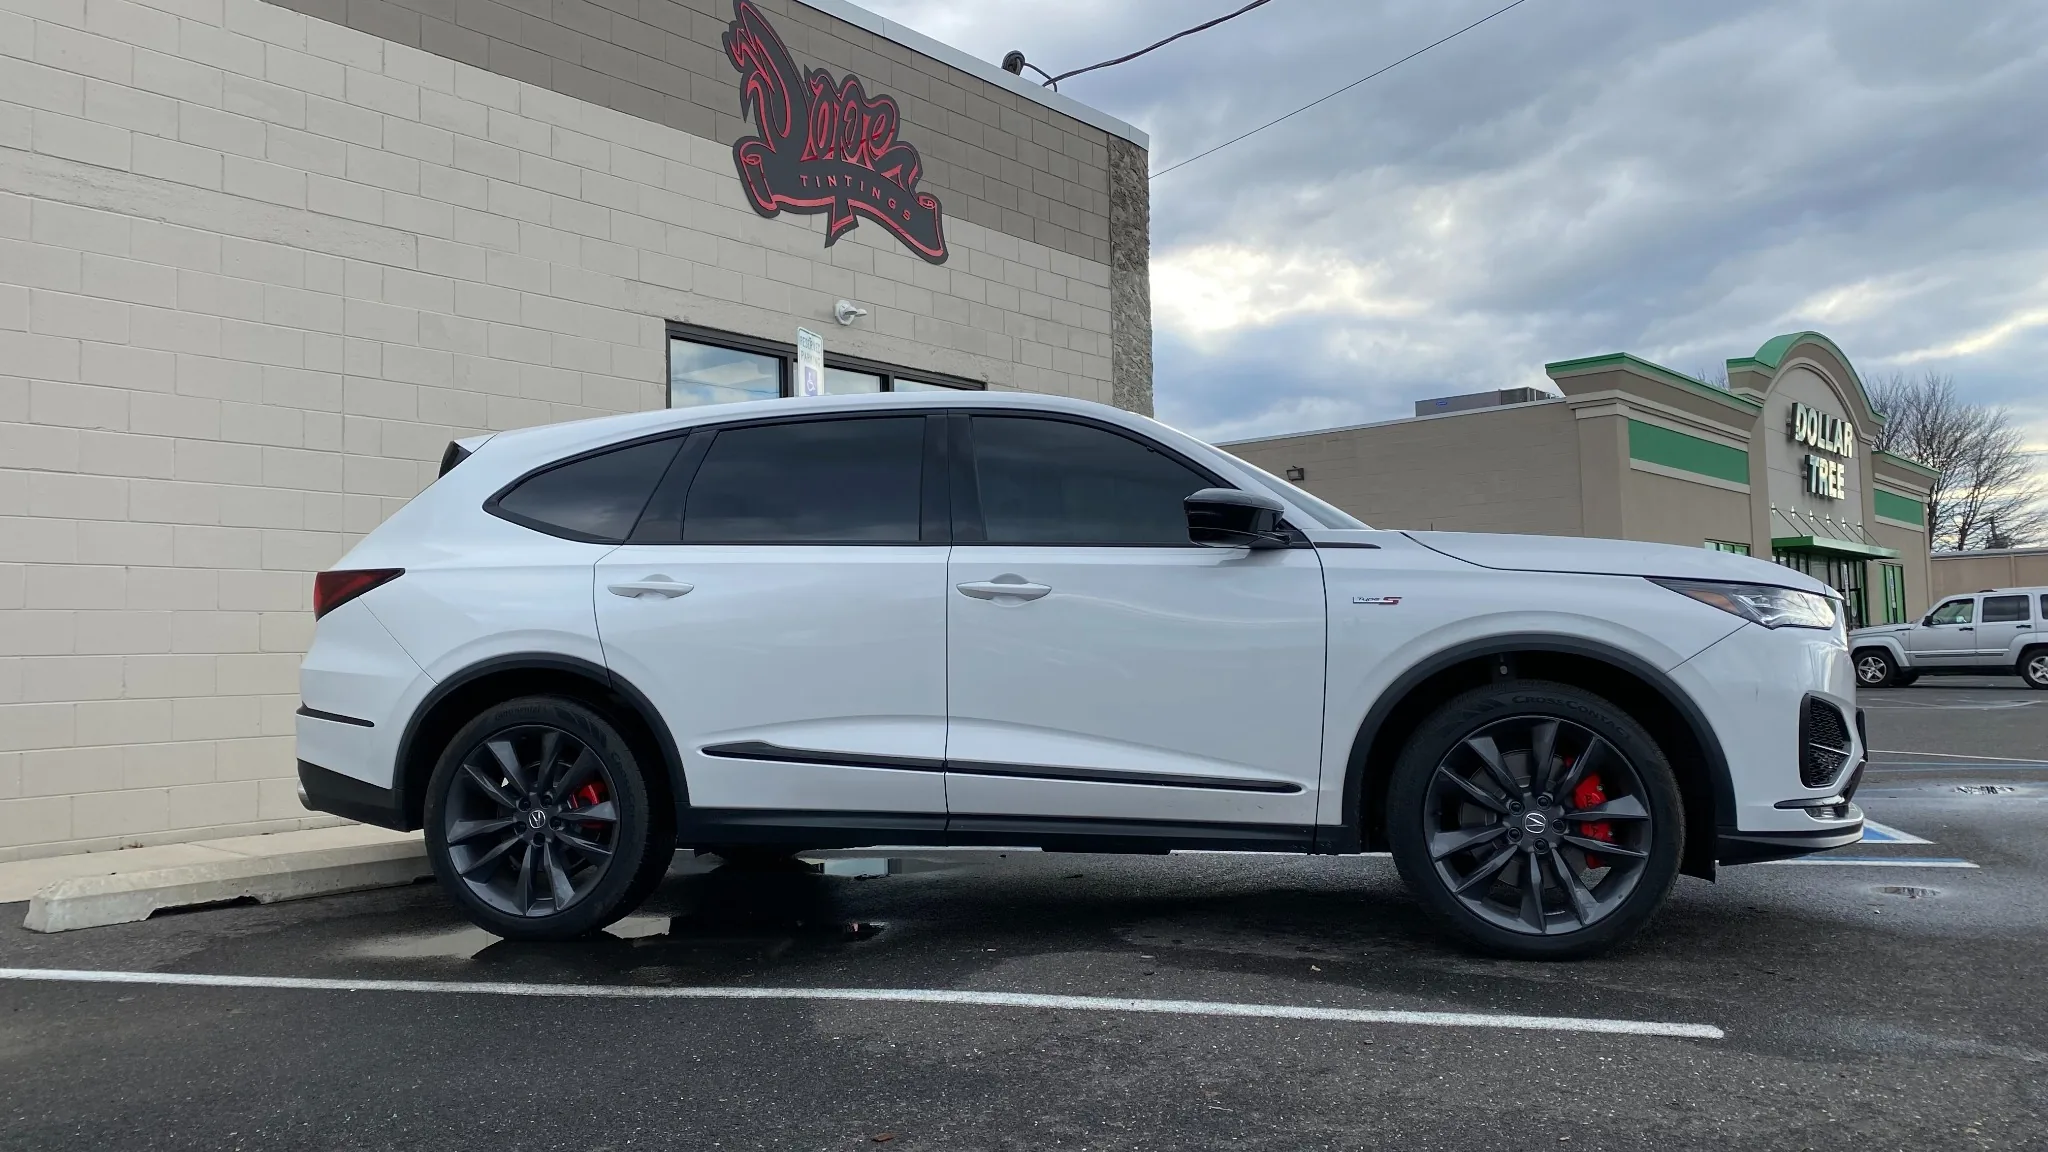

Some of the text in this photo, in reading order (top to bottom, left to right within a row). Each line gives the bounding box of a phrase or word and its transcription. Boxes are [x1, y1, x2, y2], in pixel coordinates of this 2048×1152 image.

[800, 174, 911, 221] TINTINGS
[1791, 402, 1853, 459] DOLLAR
[1805, 454, 1845, 500] TREE
[1378, 596, 1403, 606] S
